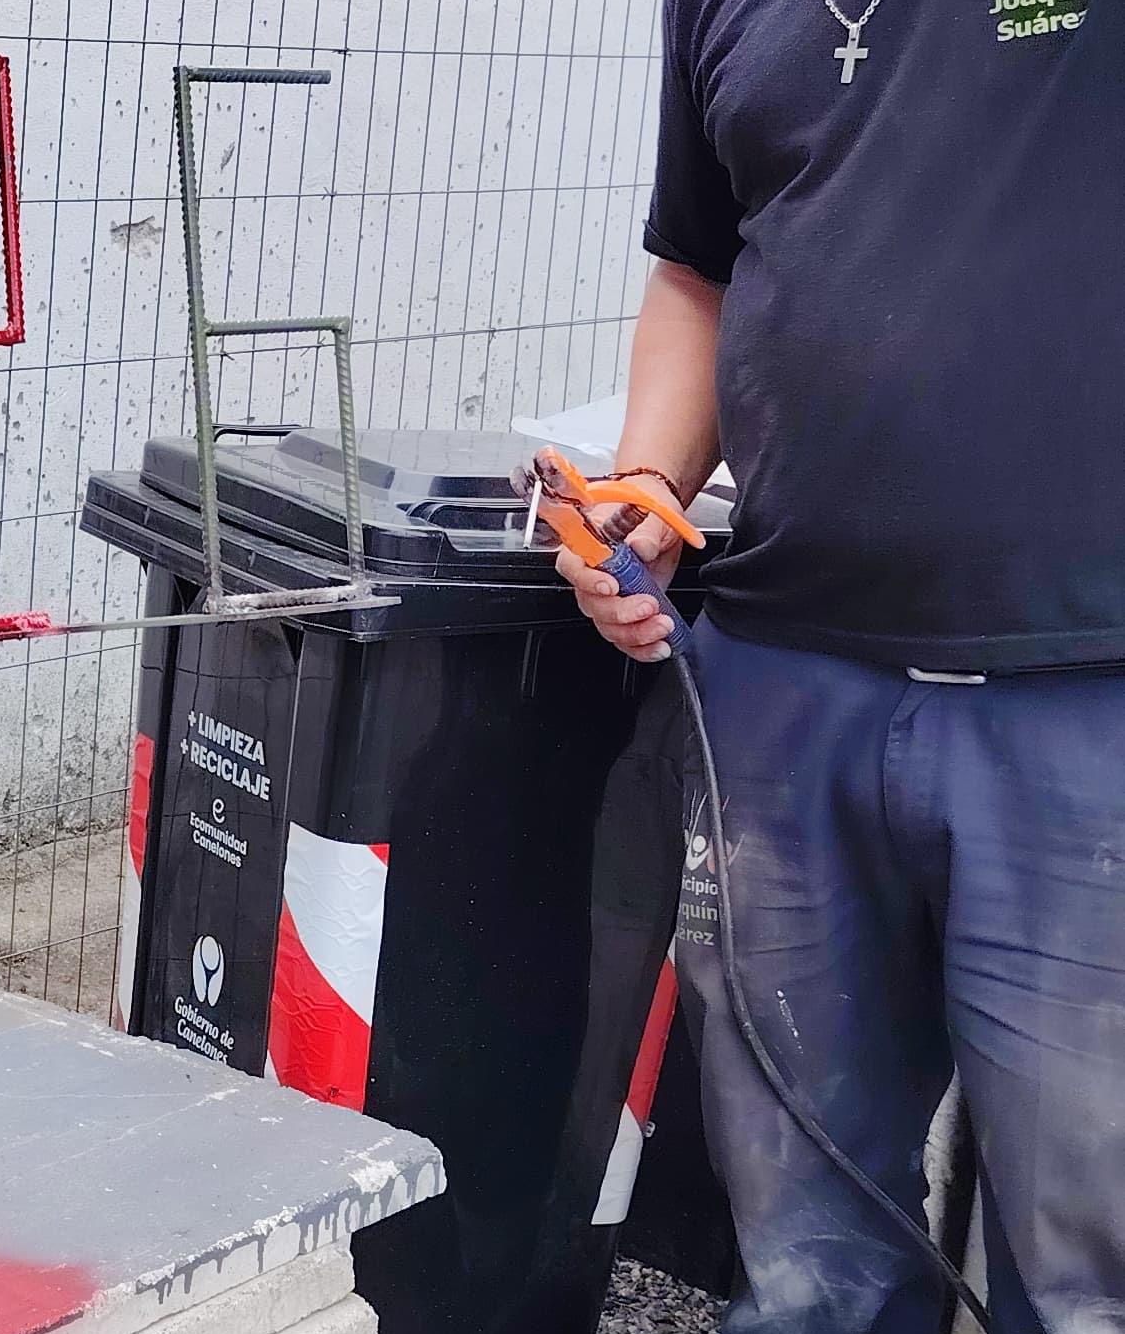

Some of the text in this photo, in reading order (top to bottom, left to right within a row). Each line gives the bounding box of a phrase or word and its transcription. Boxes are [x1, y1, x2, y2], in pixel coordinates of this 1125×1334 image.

[197, 712, 266, 766] LIMPIEZA
[190, 740, 271, 801] RECICLAJE
[189, 811, 248, 856] Ecomunidad
[192, 829, 242, 868] Canelones
[681, 874, 719, 896] icipio
[681, 900, 718, 921] quín
[174, 996, 235, 1050] Gobierno de
